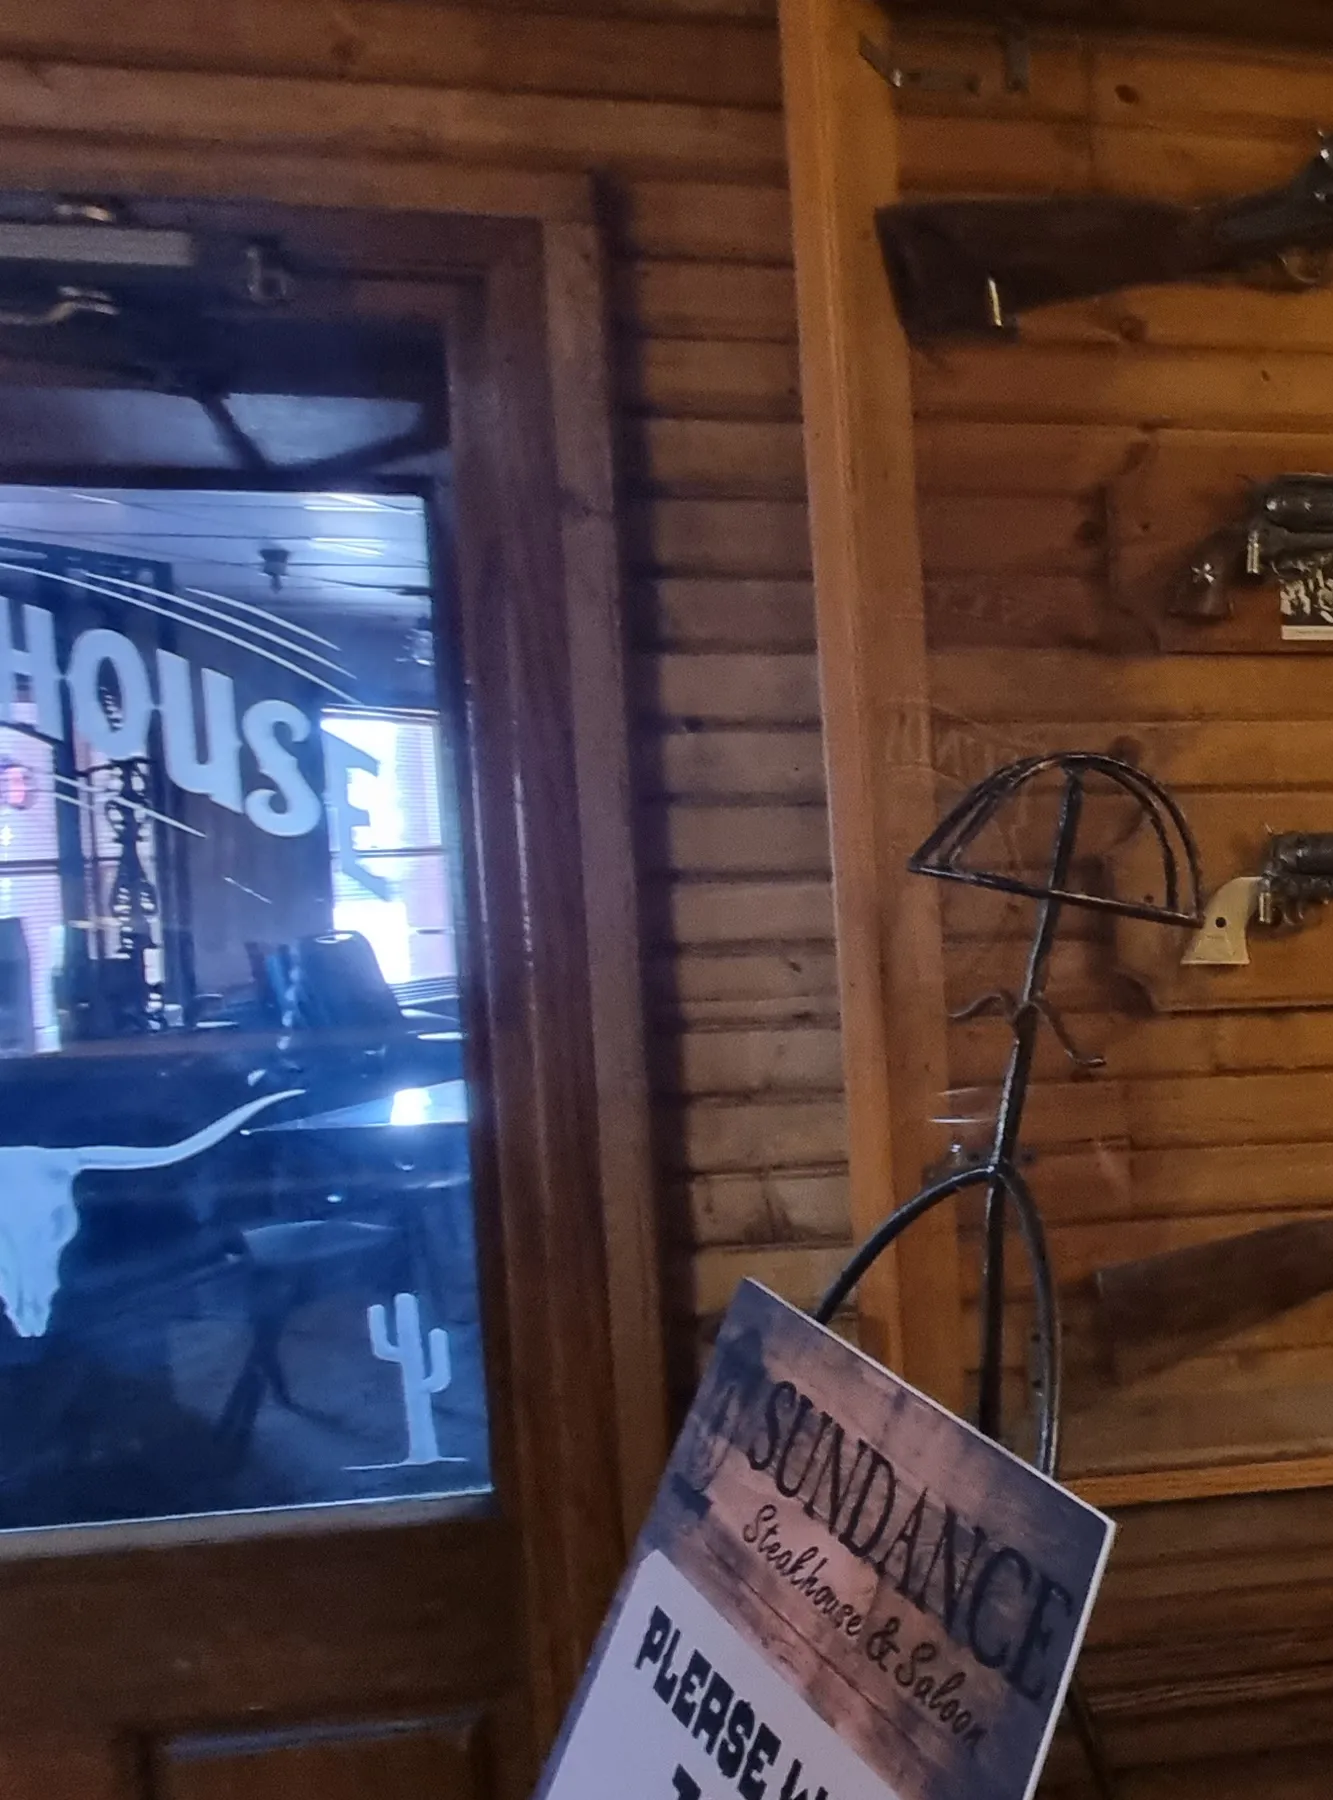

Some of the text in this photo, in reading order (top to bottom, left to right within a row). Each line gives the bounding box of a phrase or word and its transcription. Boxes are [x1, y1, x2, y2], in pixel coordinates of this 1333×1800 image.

[742, 1503, 988, 1744] Steakhouse & Saloon
[746, 1380, 1073, 1701] SUNDANCE
[633, 1604, 782, 1800] PLEASE
